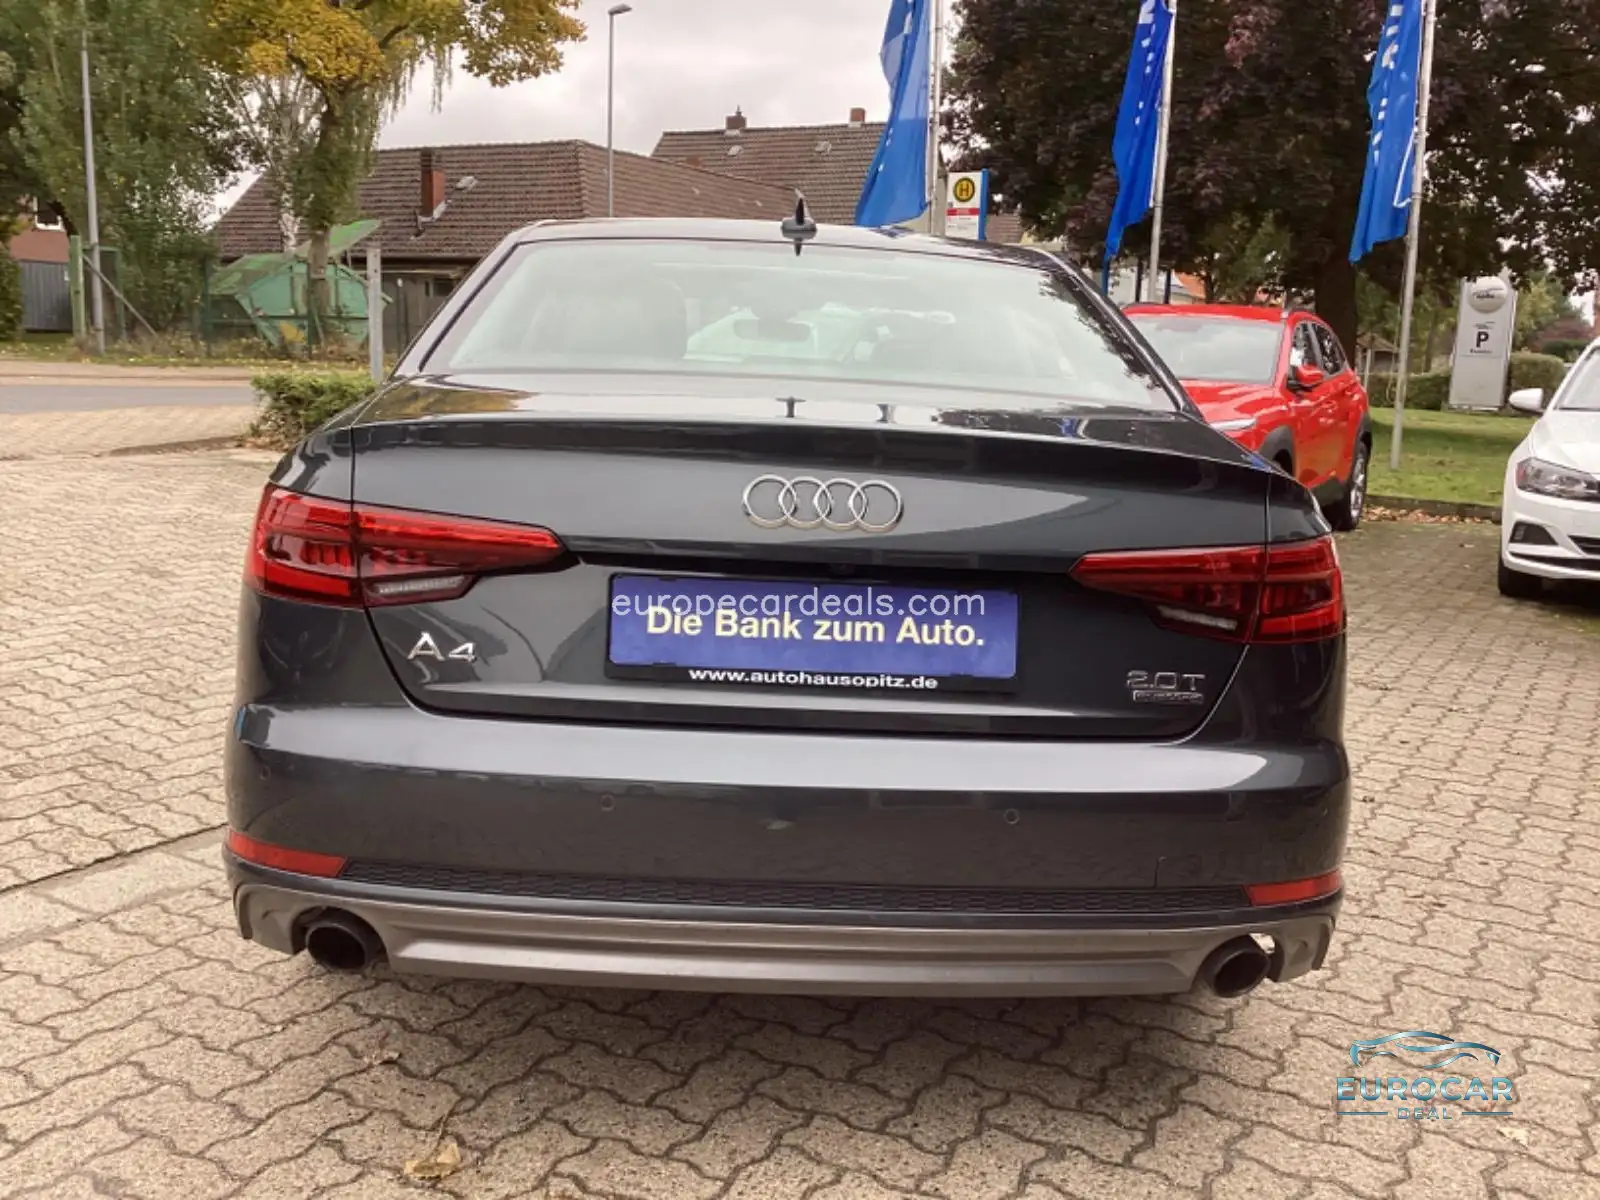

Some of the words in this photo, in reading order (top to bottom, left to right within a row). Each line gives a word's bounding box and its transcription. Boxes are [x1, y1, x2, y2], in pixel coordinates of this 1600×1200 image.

[959, 183, 970, 197] H
[1476, 331, 1490, 348] P
[647, 605, 703, 636] Die
[714, 608, 803, 640] Bank
[812, 618, 885, 643] zum
[896, 617, 984, 646] Auto.
[407, 631, 477, 662] A4
[688, 668, 939, 689] www.autohausopitz.de
